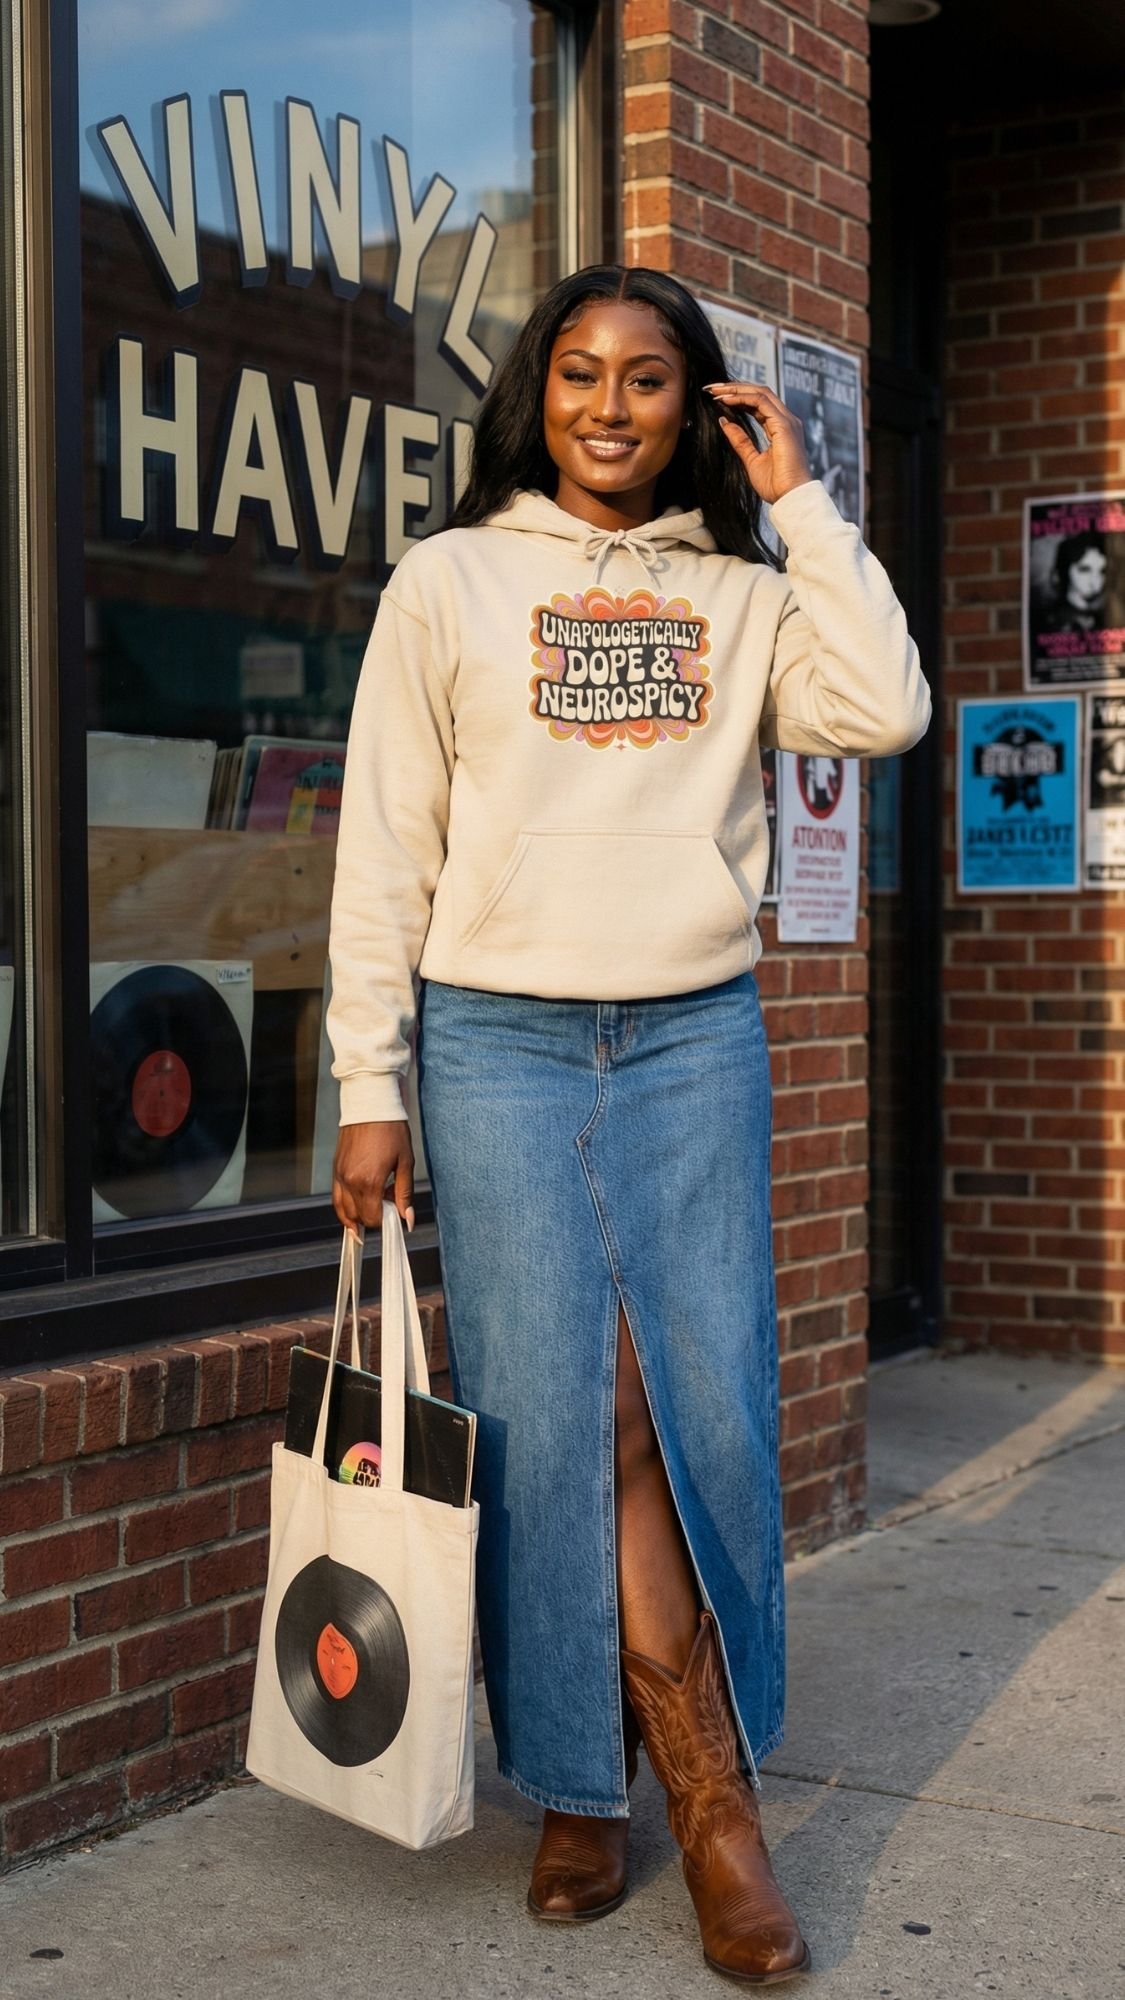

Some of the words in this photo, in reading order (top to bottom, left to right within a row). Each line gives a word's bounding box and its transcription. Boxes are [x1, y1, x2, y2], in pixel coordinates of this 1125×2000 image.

[98, 90, 497, 397] VINYL
[565, 648, 646, 685] DOPE
[650, 646, 678, 681] &
